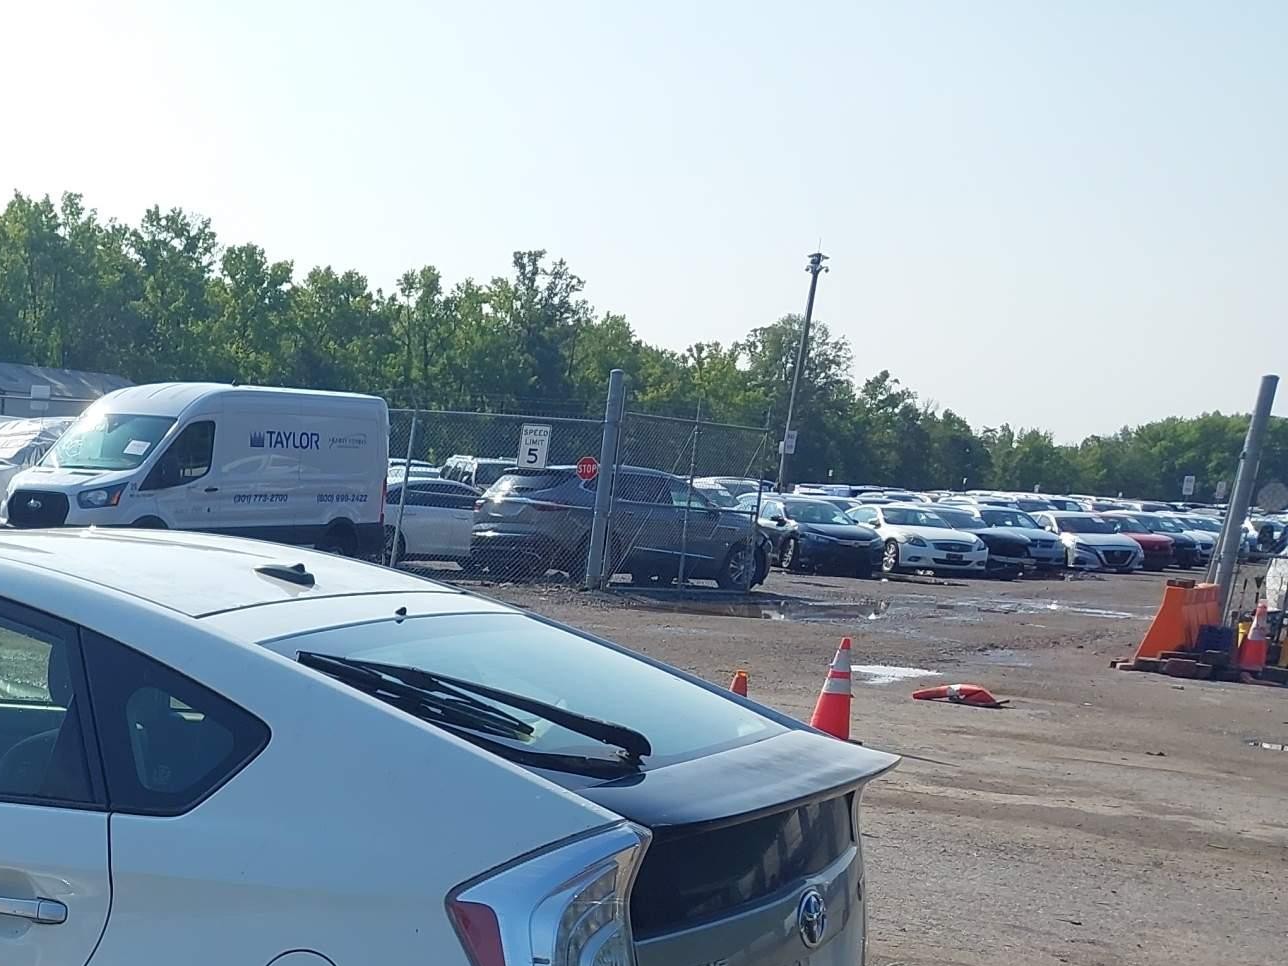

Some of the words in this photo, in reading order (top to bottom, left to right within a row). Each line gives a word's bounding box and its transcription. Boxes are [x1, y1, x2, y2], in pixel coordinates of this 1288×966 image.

[523, 429, 548, 437] SPEED
[266, 430, 320, 450] TAYLOR
[526, 448, 538, 464] 5
[578, 464, 597, 474] STOP
